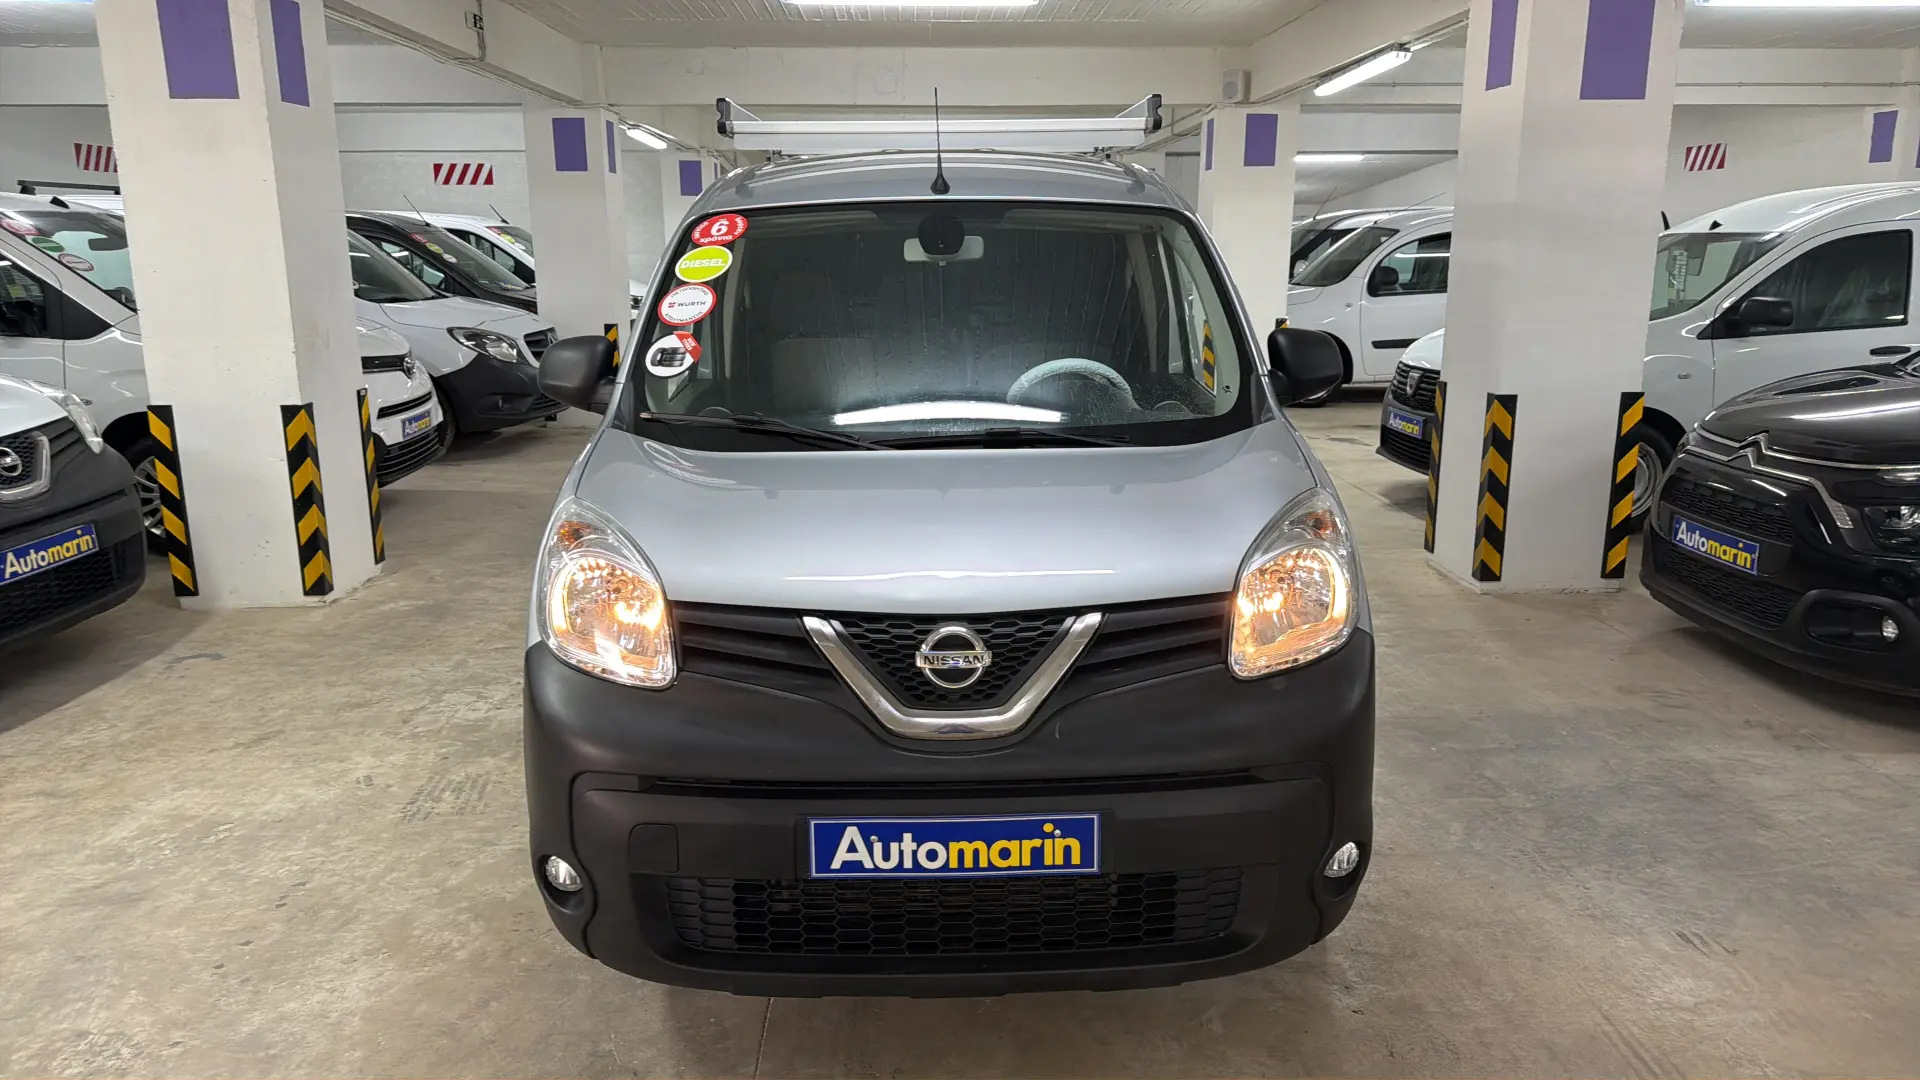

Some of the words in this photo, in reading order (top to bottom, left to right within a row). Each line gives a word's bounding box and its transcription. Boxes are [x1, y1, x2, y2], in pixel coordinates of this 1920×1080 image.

[710, 220, 730, 236] 6
[680, 258, 726, 269] DIESEL
[4, 529, 94, 579] Automarin
[1676, 521, 1752, 569] Automarin
[923, 655, 985, 666] NISSAN
[830, 822, 1081, 870] Automarin
